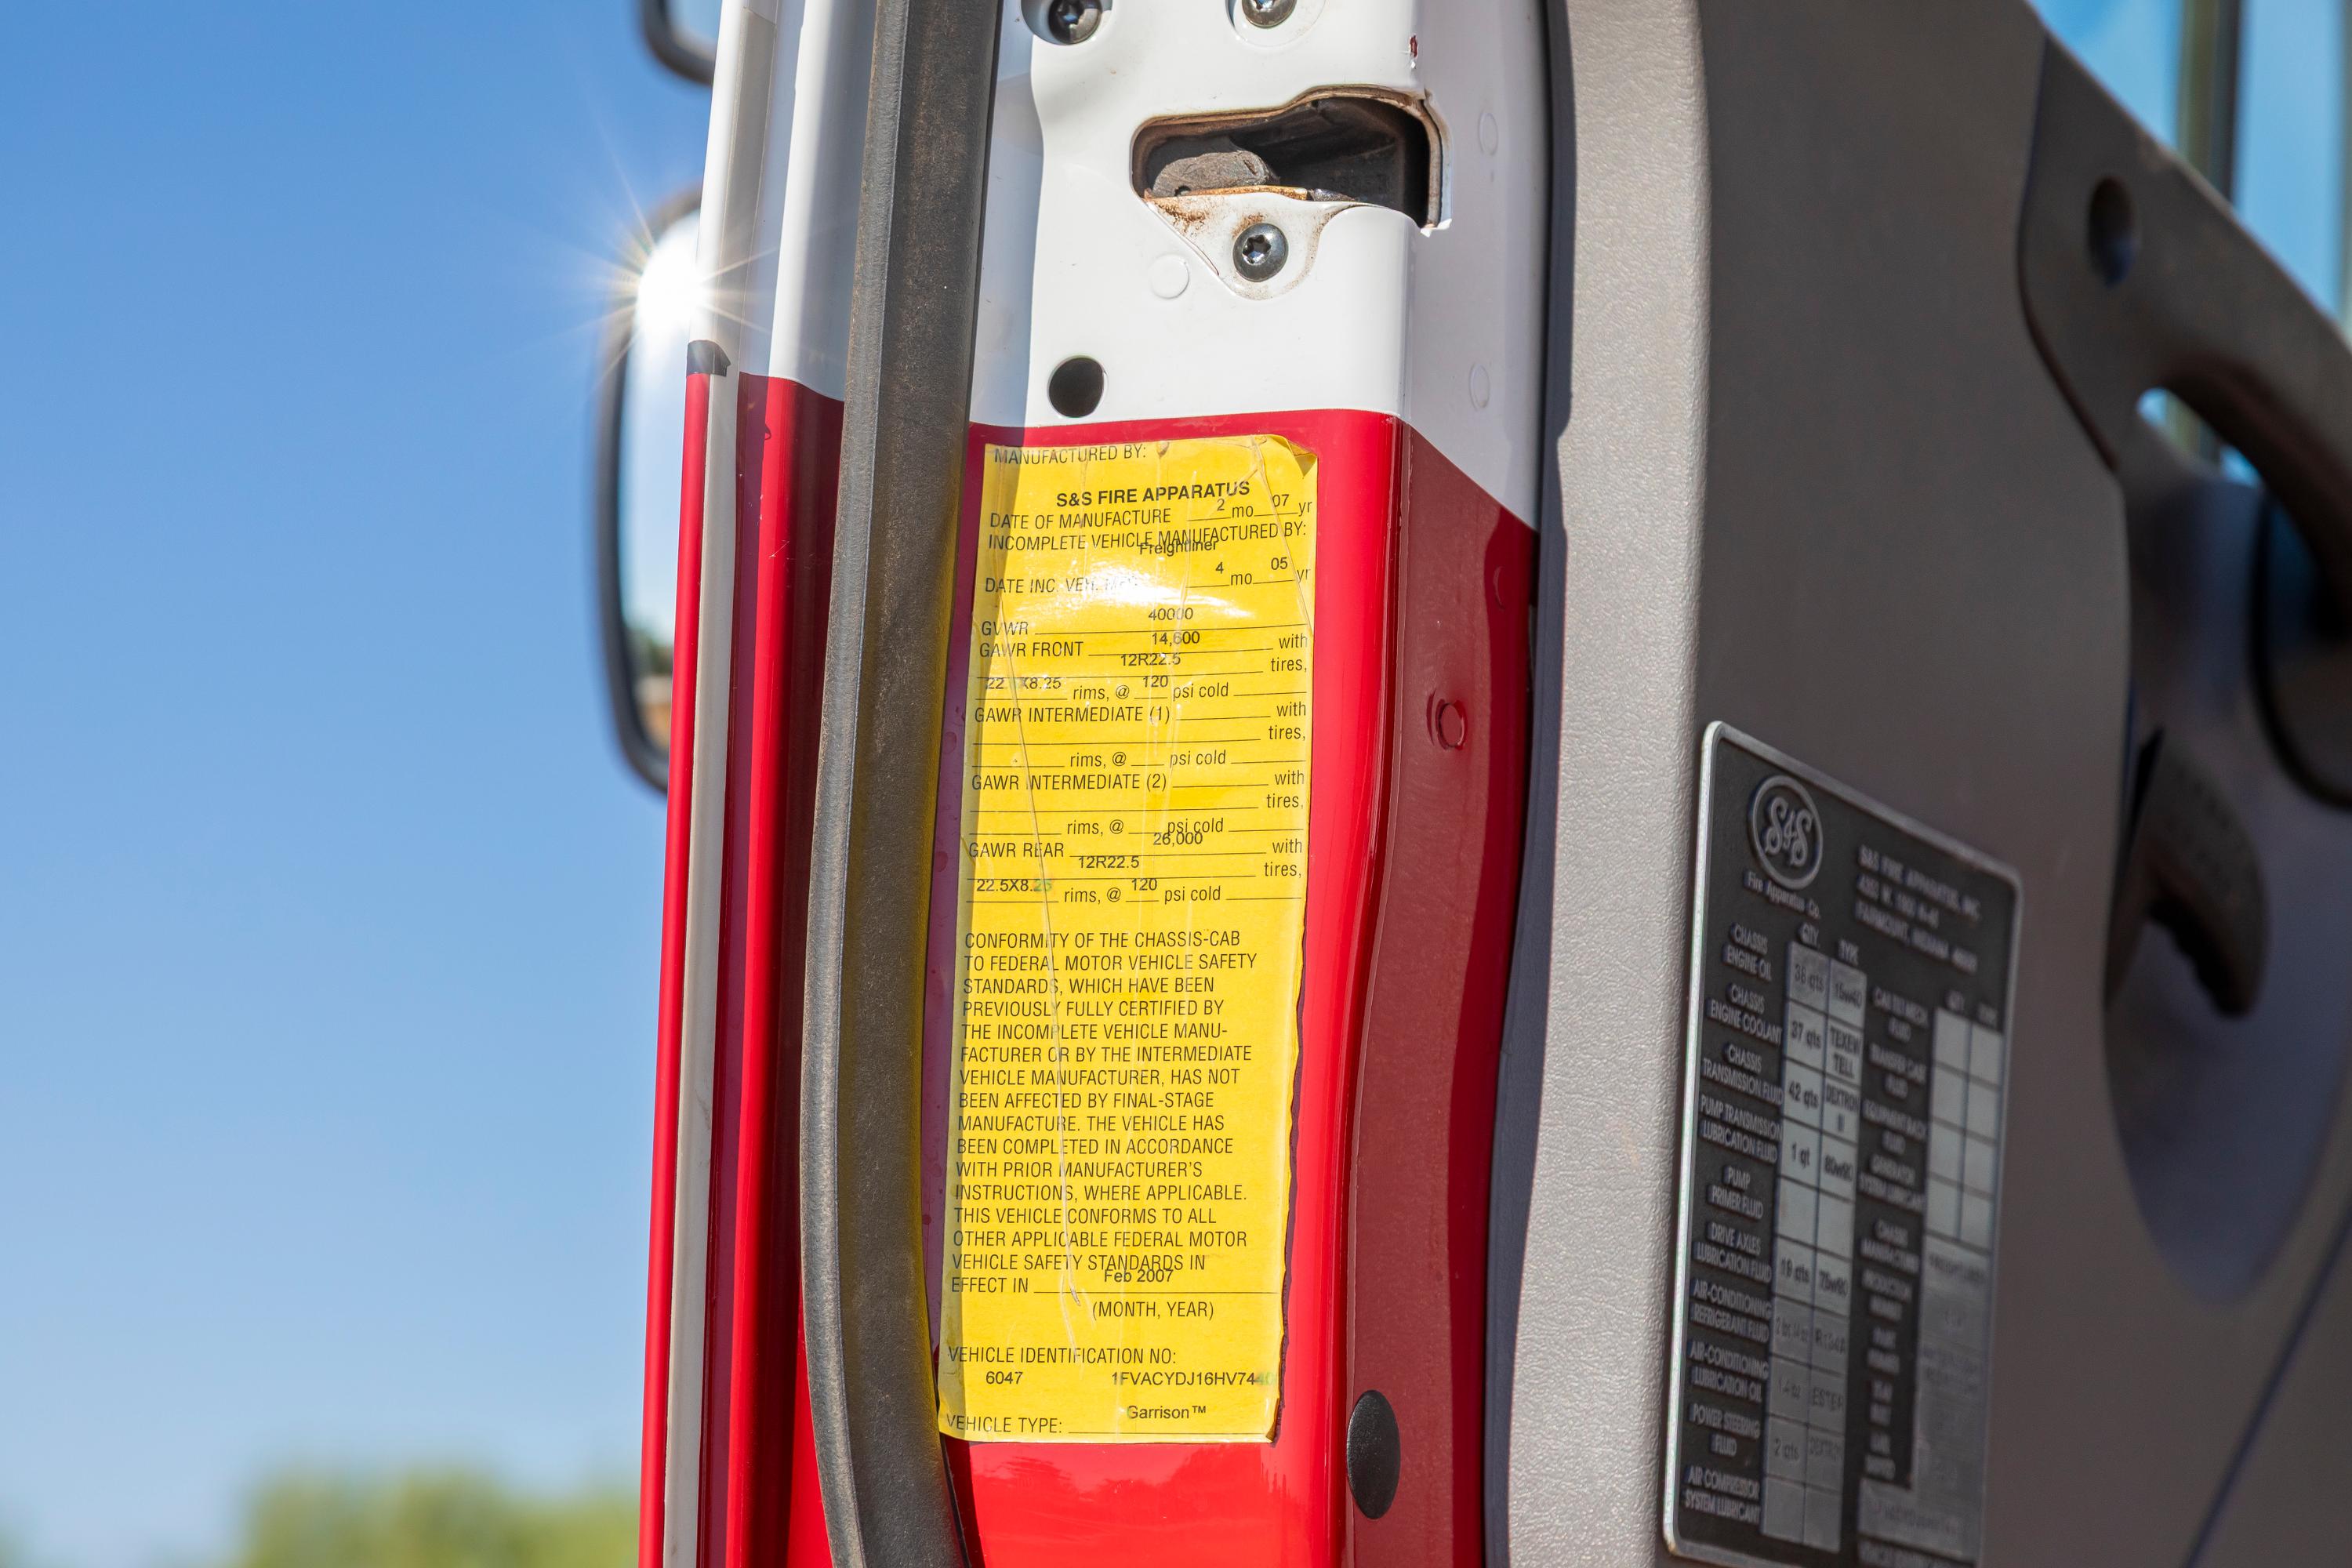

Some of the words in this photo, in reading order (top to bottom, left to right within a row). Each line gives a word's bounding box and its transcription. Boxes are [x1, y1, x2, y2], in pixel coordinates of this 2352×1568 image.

[995, 445, 1118, 464] MANUFACTURED
[1123, 444, 1147, 459] BY:
[1056, 492, 1092, 507] S&S
[1098, 488, 1138, 505] FIRE
[1143, 481, 1250, 502] APPARATUS
[990, 513, 1029, 529] DATE
[1035, 514, 1054, 529] OF
[1059, 508, 1171, 528] MANUFACTURE
[1216, 498, 1225, 511] 2
[1232, 506, 1254, 518] mo
[1272, 494, 1290, 508] 07
[1298, 501, 1313, 517] yr
[989, 535, 1087, 550] INCOMPLETE
[1091, 532, 1153, 550] VEHICLE
[1158, 523, 1279, 545] MANUFACTURED
[1283, 521, 1307, 538] BY:
[1138, 539, 1219, 557] Freightliner
[985, 577, 1025, 593] DATE
[1030, 579, 1058, 593] INC.
[1215, 562, 1225, 574] 4
[1231, 573, 1253, 586] mo
[1271, 557, 1289, 571] 05
[1148, 608, 1194, 621] 40000
[982, 620, 1029, 636] GVWR
[1032, 641, 1084, 657] FRONT
[1279, 633, 1308, 650] with
[1151, 631, 1201, 647] 14,600
[1120, 652, 1181, 667] 12R22.5
[1271, 657, 1308, 673] tires,
[1073, 685, 1109, 702] rims,
[1115, 684, 1131, 699] @
[1173, 684, 1195, 702] psi
[1199, 682, 1229, 698] cold
[975, 707, 1022, 723] GAWR
[1029, 706, 1144, 722] INTERMEDIATE
[1149, 706, 1171, 725] (1)
[1276, 702, 1307, 717] with
[1269, 725, 1306, 741] tires,
[969, 842, 1016, 858] GAWR
[1023, 842, 1064, 857] REAR
[1272, 838, 1303, 854] with
[1153, 832, 1203, 848] 26,000
[1078, 855, 1140, 869] 12R22.5
[1264, 862, 1301, 877] tires,
[1064, 887, 1101, 904] rims,
[1106, 887, 1122, 902] @
[1164, 887, 1185, 905] psi
[1190, 885, 1221, 901] cold
[1131, 878, 1158, 891] 120
[965, 933, 1069, 948] CONFORMITY
[1075, 933, 1094, 948] OF
[1099, 933, 1129, 948] THE
[1135, 931, 1240, 948] CHASSIS-CAB
[1734, 924, 1769, 955] CHASSIS
[964, 956, 984, 971] TO
[990, 956, 1059, 971] FEDERAL
[1065, 955, 1122, 971] MOTOR
[1128, 954, 1193, 970] VEHICLE
[1199, 953, 1258, 969] SAFETY
[1726, 945, 1758, 975] ENGINE
[1759, 960, 1772, 982] OIL
[1730, 984, 1765, 1014] CHASSIS
[1710, 998, 1742, 1029] ENGINE
[1743, 1014, 1783, 1045] COOLANT
[1791, 1022, 1804, 1041] 37
[1806, 1029, 1822, 1049] qts
[960, 1047, 1042, 1062] FACTURER
[1048, 1047, 1069, 1062] OR
[1076, 1047, 1096, 1062] BY
[1101, 1047, 1131, 1062] THE
[1137, 1045, 1252, 1062] INTERMEDIATE
[1727, 1044, 1762, 1074] CHASSIS
[959, 1069, 1025, 1085] VEHICLE
[1031, 1069, 1164, 1087] MANUFACTURER,
[1171, 1069, 1202, 1084] HAS
[1208, 1069, 1240, 1084] NOT
[1702, 1058, 1762, 1096] TRANSMISSION
[959, 1093, 999, 1108] BEEN
[1004, 1093, 1082, 1108] AFFECTED
[1087, 1093, 1109, 1108] BY
[1113, 1092, 1214, 1108] FINAL-STAGE
[1788, 1080, 1802, 1102] 42
[1804, 1089, 1819, 1110] qts
[1700, 1094, 1724, 1119] PUMP
[1725, 1105, 1783, 1142] TRANSMISSION
[1702, 1120, 1756, 1156] LUBRICATION
[1757, 1139, 1778, 1164] FLUID
[956, 1162, 997, 1177] WITH
[1004, 1162, 1052, 1177] PRIOR
[1058, 1161, 1203, 1178] MANUFACTURER'S
[1728, 1165, 1751, 1191] PUMP
[955, 1185, 1078, 1203] INSTRUCTIONS,
[1084, 1185, 1141, 1200] WHERE
[1146, 1185, 1247, 1200] APPLICABLE.
[1711, 1185, 1741, 1212] PRIMER
[1742, 1196, 1763, 1220] FLUID
[953, 1207, 990, 1223] THIS
[996, 1208, 1062, 1224] VEHICLE
[1067, 1208, 1156, 1224] CONFORMS
[1163, 1208, 1182, 1224] TO
[1188, 1208, 1217, 1224] ALL
[953, 1231, 1006, 1247] OTHER
[1011, 1232, 1108, 1247] APPLICABLE
[1114, 1232, 1183, 1247] FEDERAL
[1189, 1231, 1247, 1247] MOTOR
[1711, 1221, 1736, 1247] DRIVE
[1737, 1230, 1761, 1255] AXLES
[952, 1254, 1018, 1270] VEHICLE
[1024, 1254, 1083, 1270] SAFETY
[1087, 1254, 1184, 1271] STANDARDS
[1190, 1254, 1205, 1270] IN
[1697, 1241, 1750, 1276] LUBRICATION
[1751, 1258, 1772, 1283] FLUID
[951, 1276, 1007, 1293] EFFECT
[1013, 1277, 1029, 1293] IN
[1104, 1269, 1132, 1283] Feb
[1137, 1269, 1174, 1283] 2007
[1693, 1279, 1773, 1320] AIR-CONDITIONING
[1093, 1301, 1160, 1320] (MONTH,
[1167, 1301, 1214, 1320] YEAR)
[948, 1346, 1014, 1363] VEHICLE
[1021, 1348, 1143, 1363] IDENTIFICATION
[1150, 1348, 1177, 1363] NO:
[1690, 1340, 1769, 1381] AIR-CONDITIONING
[985, 1371, 1023, 1385] 6047
[1749, 1381, 1763, 1403] OIL
[946, 1413, 1012, 1433] VEHICLE
[1018, 1417, 1062, 1434] TYPE:
[1692, 1403, 1722, 1429] POWER
[1723, 1411, 1761, 1439] STEERING
[1687, 1464, 1703, 1486] AIR
